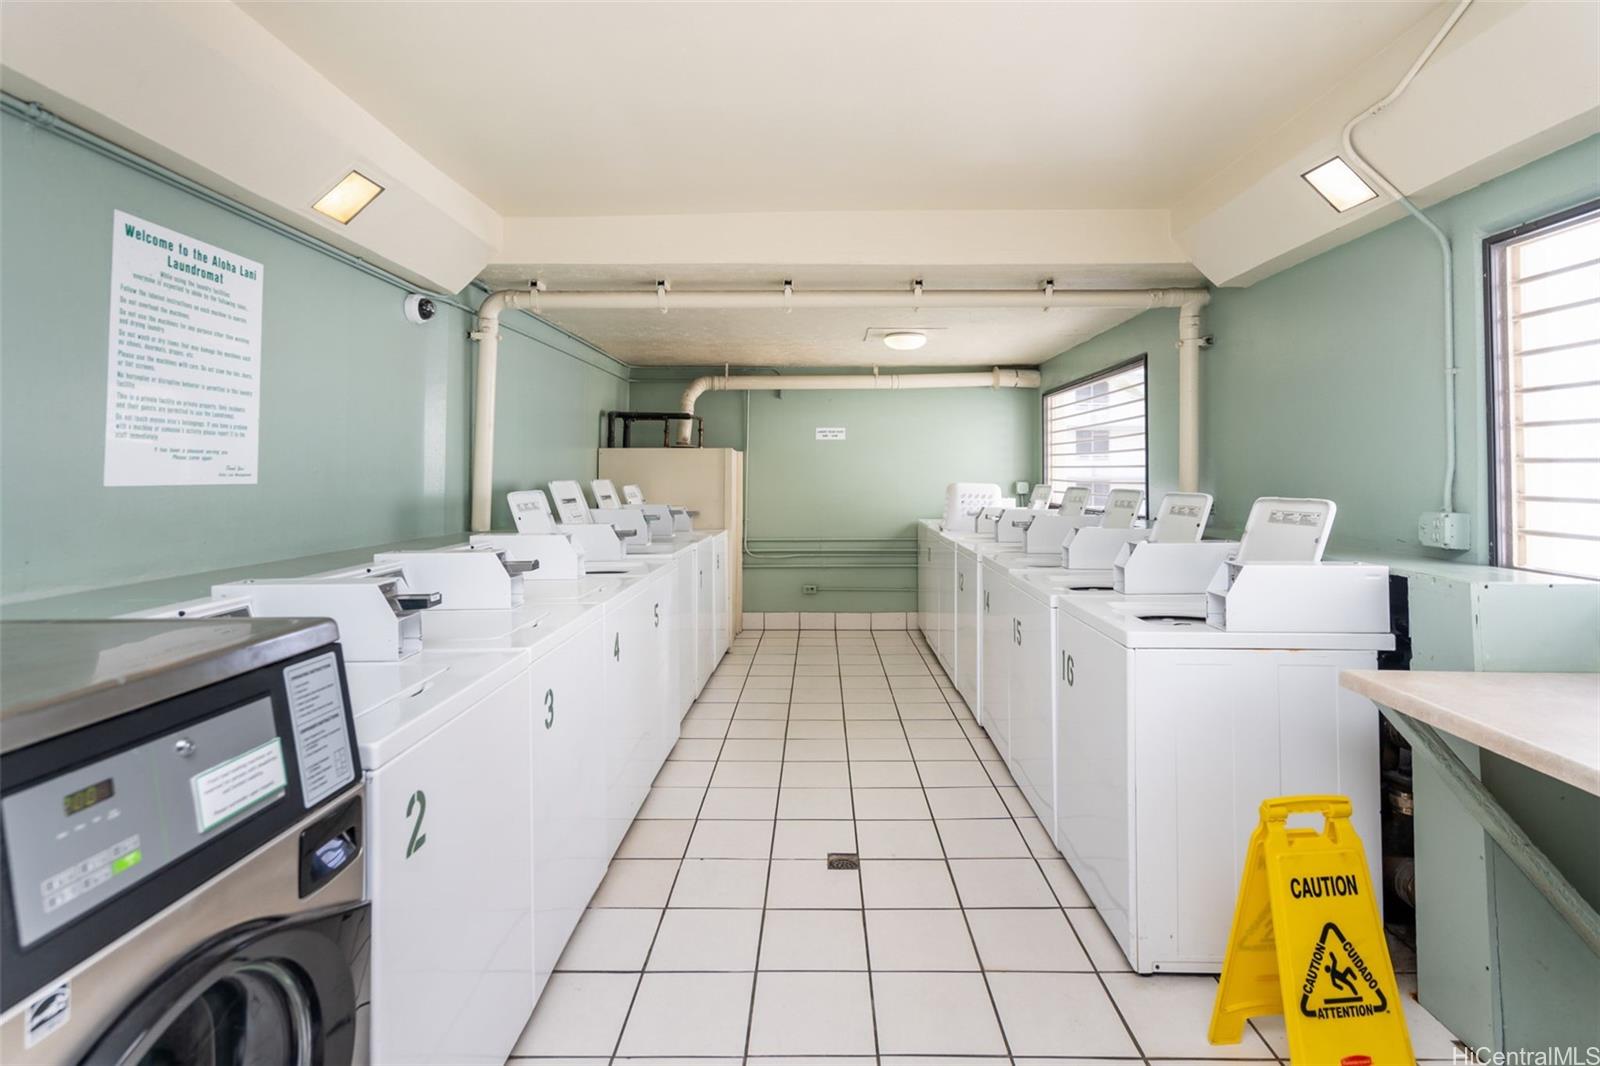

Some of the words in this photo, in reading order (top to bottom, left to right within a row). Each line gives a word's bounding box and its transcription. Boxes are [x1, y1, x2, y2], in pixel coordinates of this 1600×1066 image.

[124, 223, 174, 252] Welcome
[179, 243, 189, 257] to
[193, 248, 208, 264] the
[212, 255, 237, 274] Aloha
[240, 265, 257, 281] Lani
[167, 255, 224, 284] Laundromat
[654, 602, 660, 628] 5
[1012, 617, 1022, 647] 15
[613, 631, 620, 662] 4
[1062, 649, 1075, 687] 16
[543, 688, 554, 730] 3
[406, 789, 427, 860] 2
[1290, 874, 1359, 899] CAUTION
[1303, 942, 1326, 994] CAUTION
[1343, 941, 1378, 990] CUIDADO
[1317, 1003, 1374, 1020] ATTENTION
